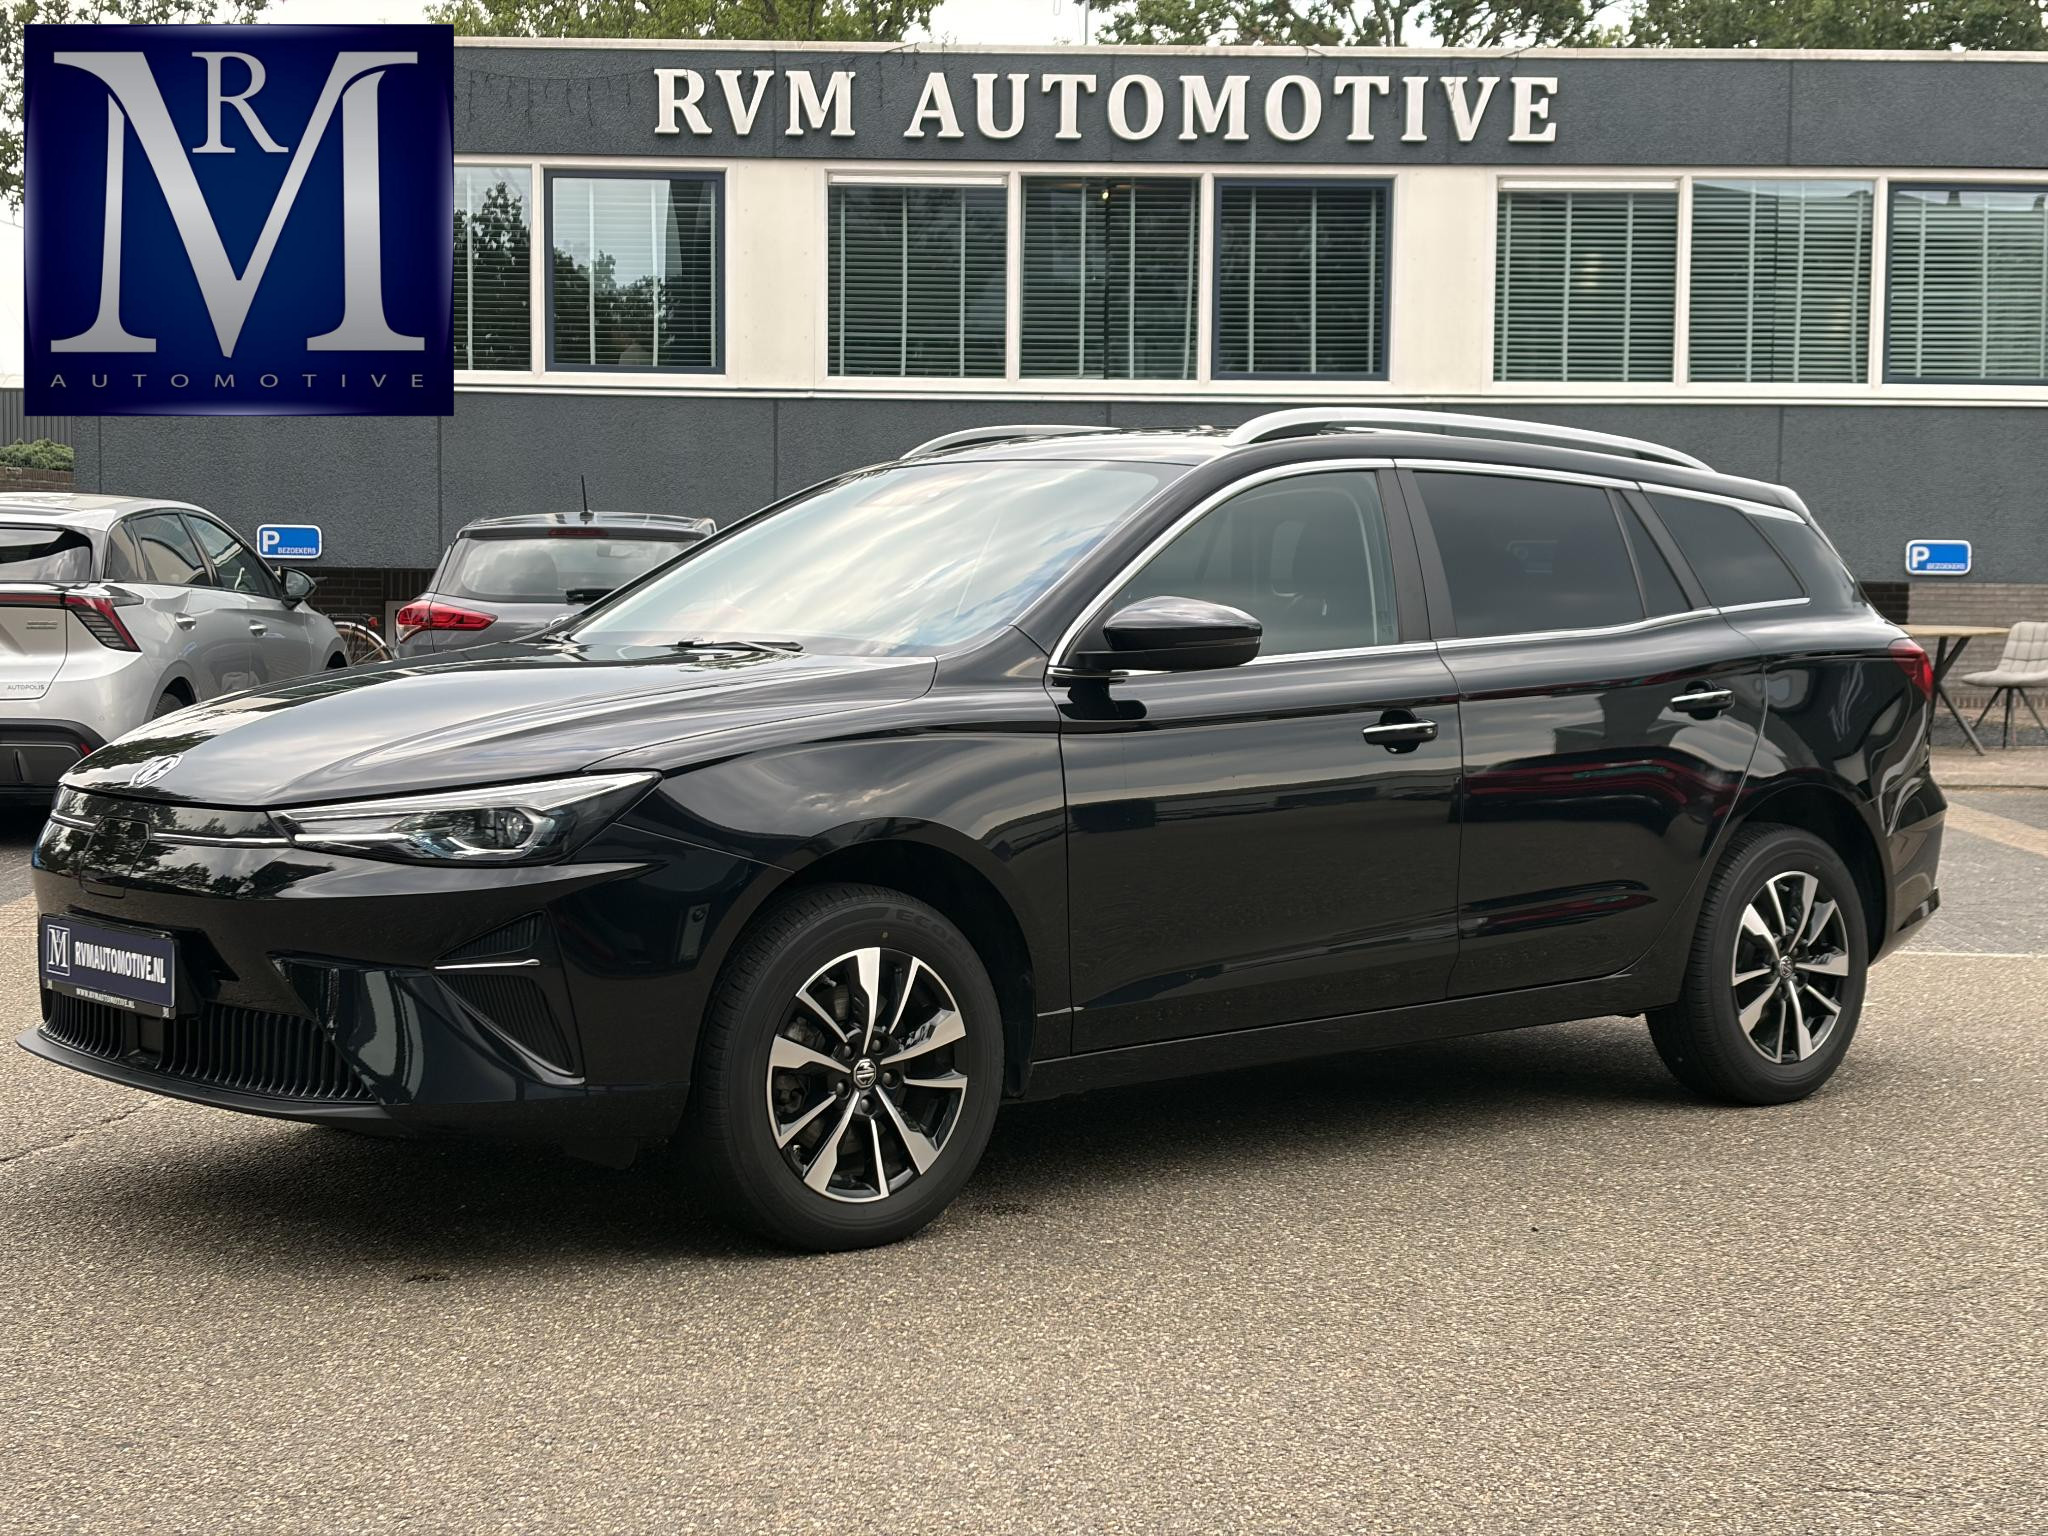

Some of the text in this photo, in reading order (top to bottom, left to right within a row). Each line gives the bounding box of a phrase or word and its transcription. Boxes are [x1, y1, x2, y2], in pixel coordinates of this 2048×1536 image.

[653, 68, 1559, 143] RVM AUTOMOTIVE
[262, 530, 280, 552] P
[1911, 546, 1930, 569] P
[75, 941, 166, 983] RVMAUTOMOTIVE.NL
